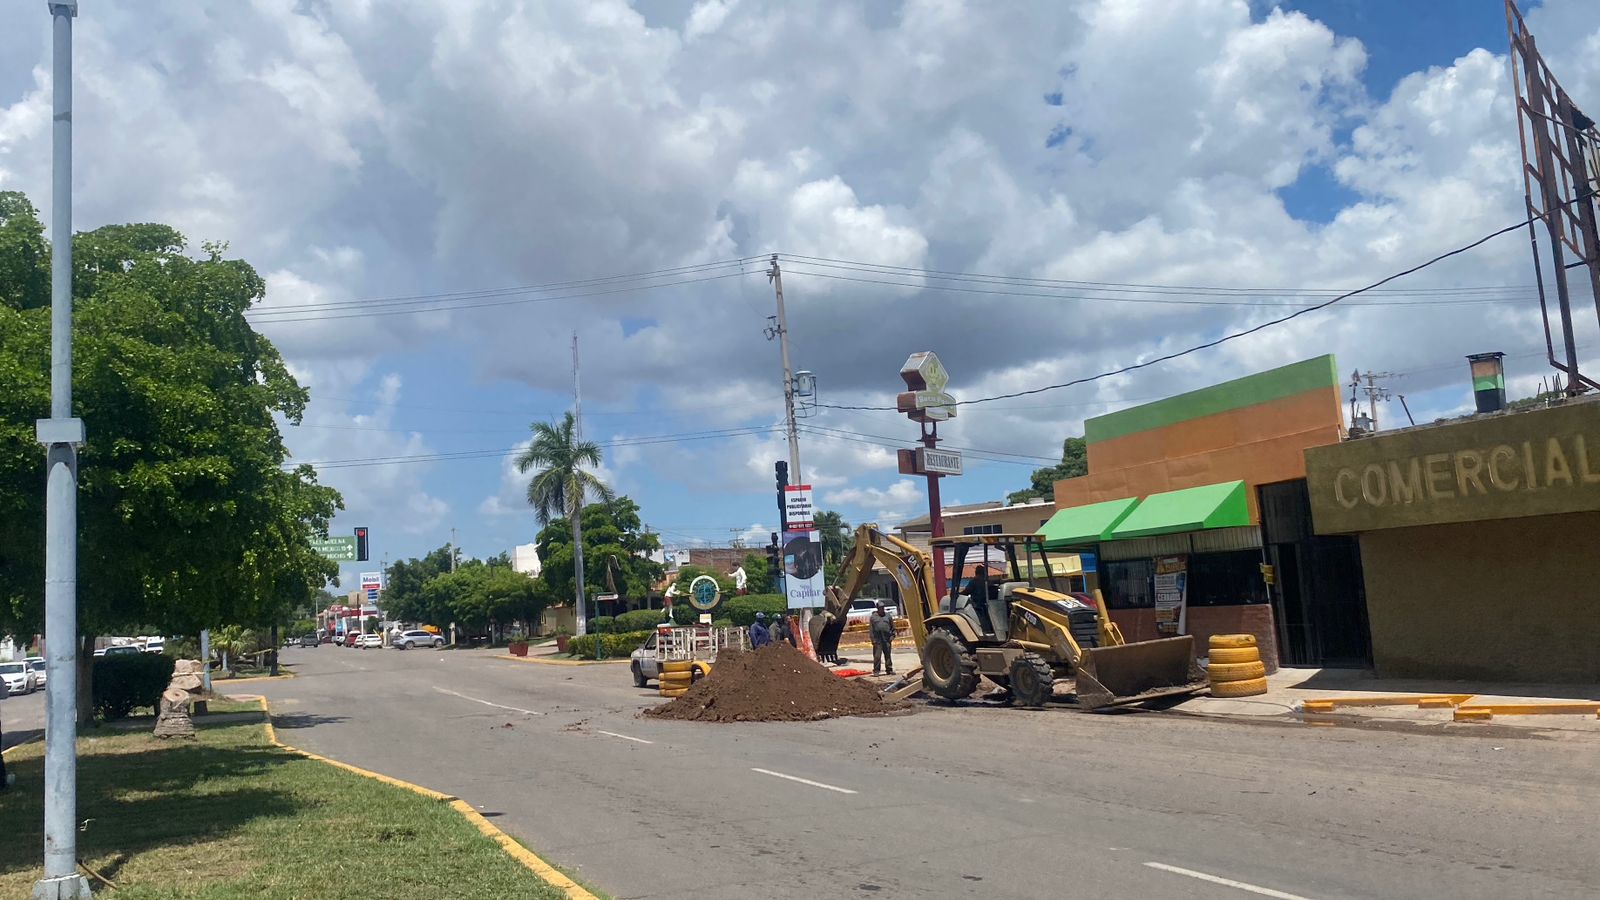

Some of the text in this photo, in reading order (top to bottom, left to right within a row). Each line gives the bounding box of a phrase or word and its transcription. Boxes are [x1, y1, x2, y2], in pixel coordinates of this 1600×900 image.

[926, 453, 960, 470] RESTAURANTE
[1333, 434, 1600, 509] COMERCIAL
[907, 554, 921, 572] CAT
[790, 589, 820, 599] Capilar
